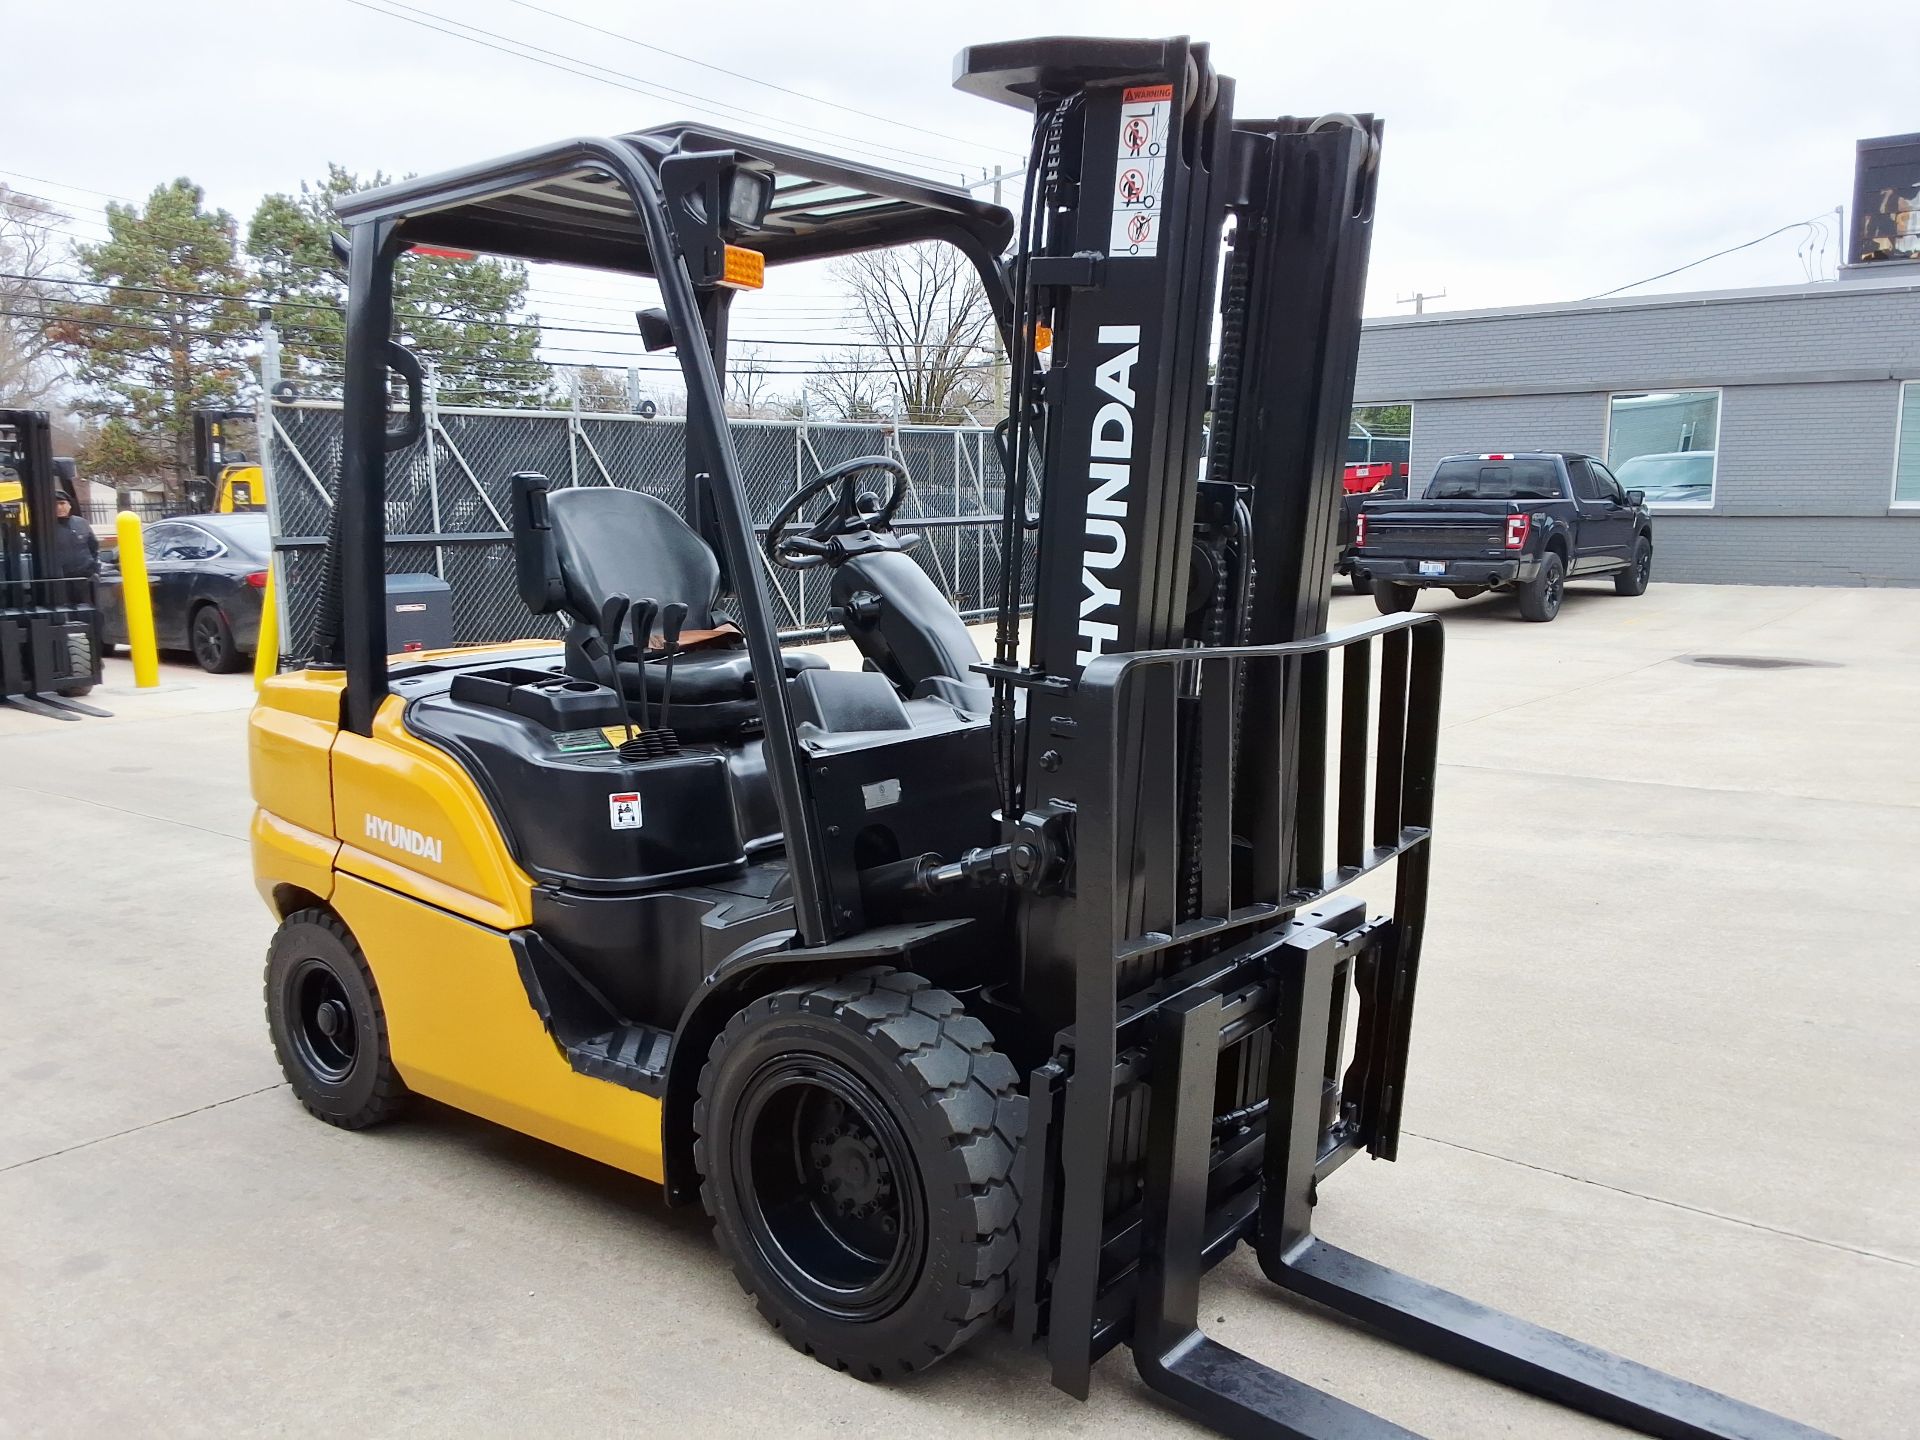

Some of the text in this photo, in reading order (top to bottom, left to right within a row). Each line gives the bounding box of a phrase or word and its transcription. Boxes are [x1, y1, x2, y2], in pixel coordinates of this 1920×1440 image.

[1133, 89, 1171, 99] WARNING
[1076, 325, 1141, 666] HYUNDAI
[365, 813, 442, 864] HYUNDAI
